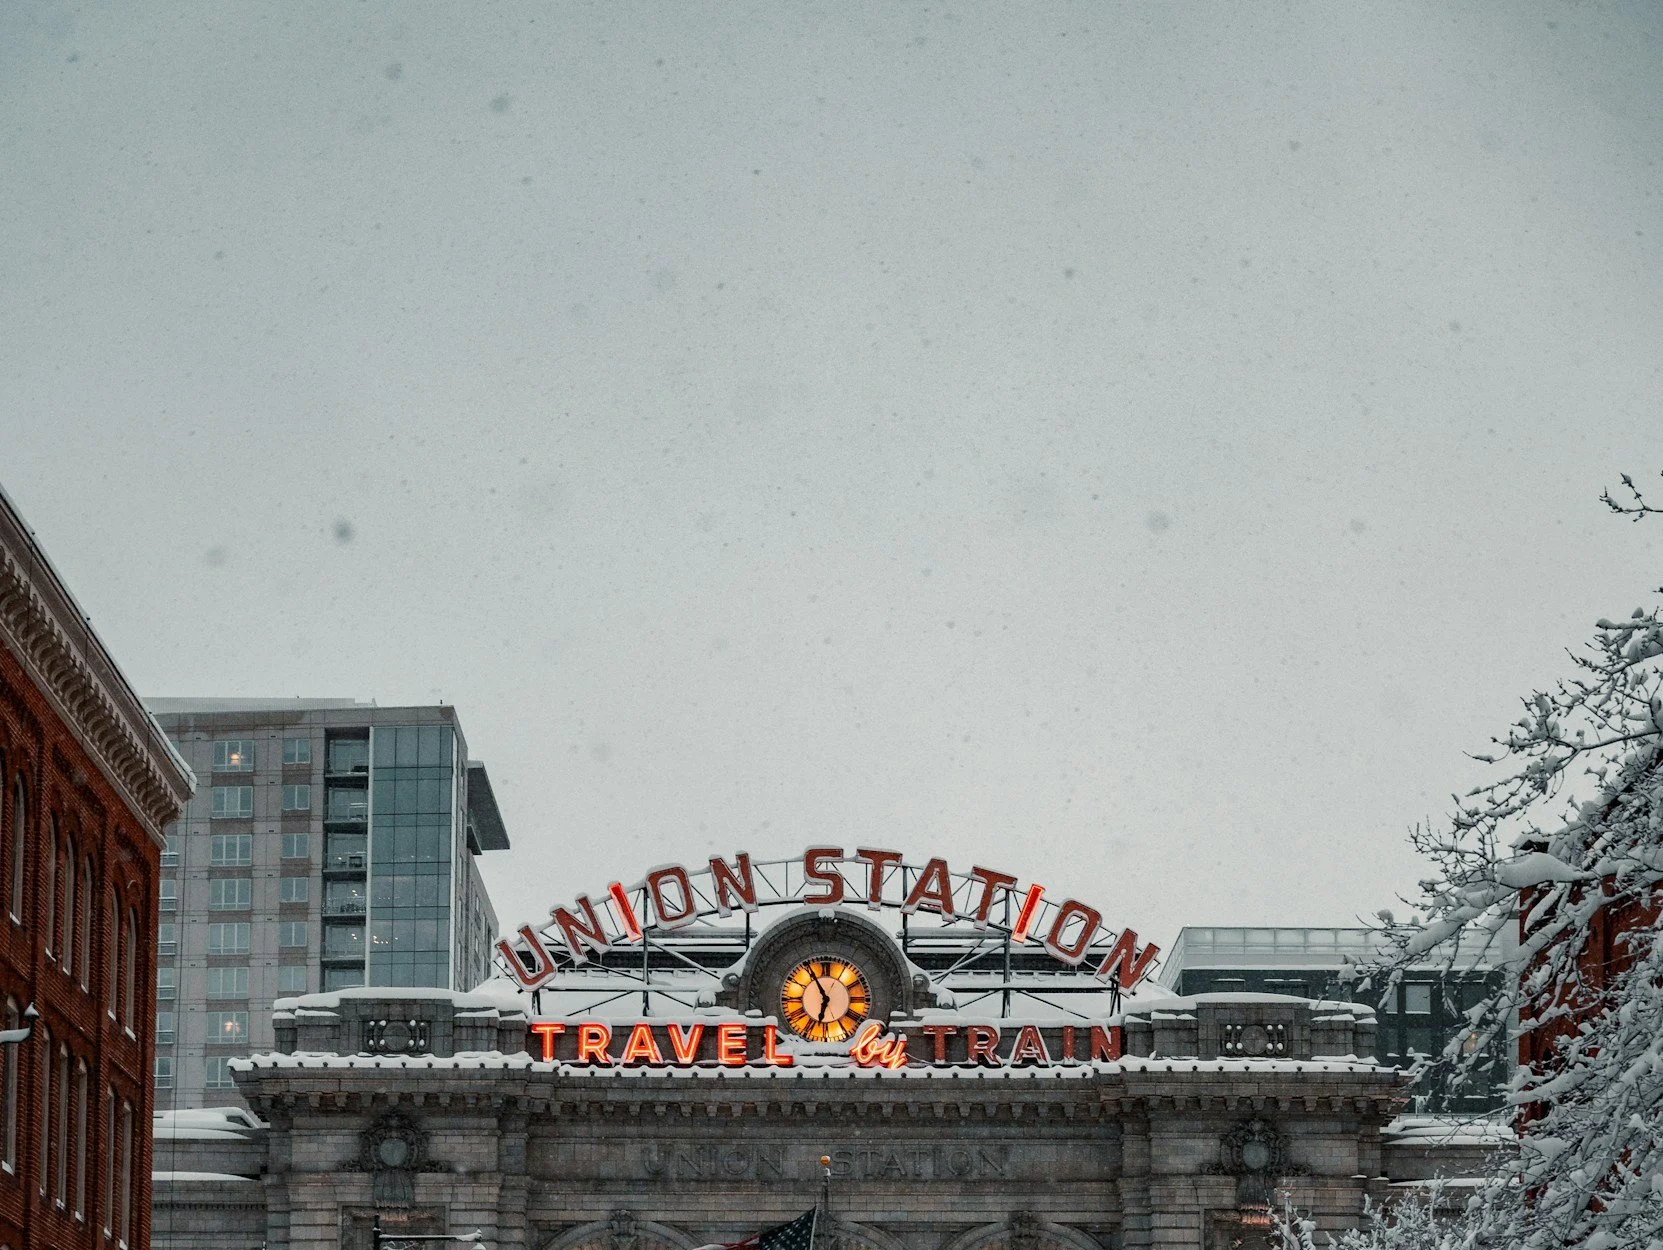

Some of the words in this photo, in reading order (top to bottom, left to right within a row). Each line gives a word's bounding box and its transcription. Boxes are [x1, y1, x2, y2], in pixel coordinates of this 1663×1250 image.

[496, 851, 758, 991] UNION
[803, 845, 1160, 997] STATION
[531, 1023, 793, 1065] TRAVEL
[850, 1023, 907, 1069] by
[923, 1025, 1121, 1065] TRAIN
[642, 1149, 784, 1176] UNION
[829, 1149, 1005, 1176] STATION
